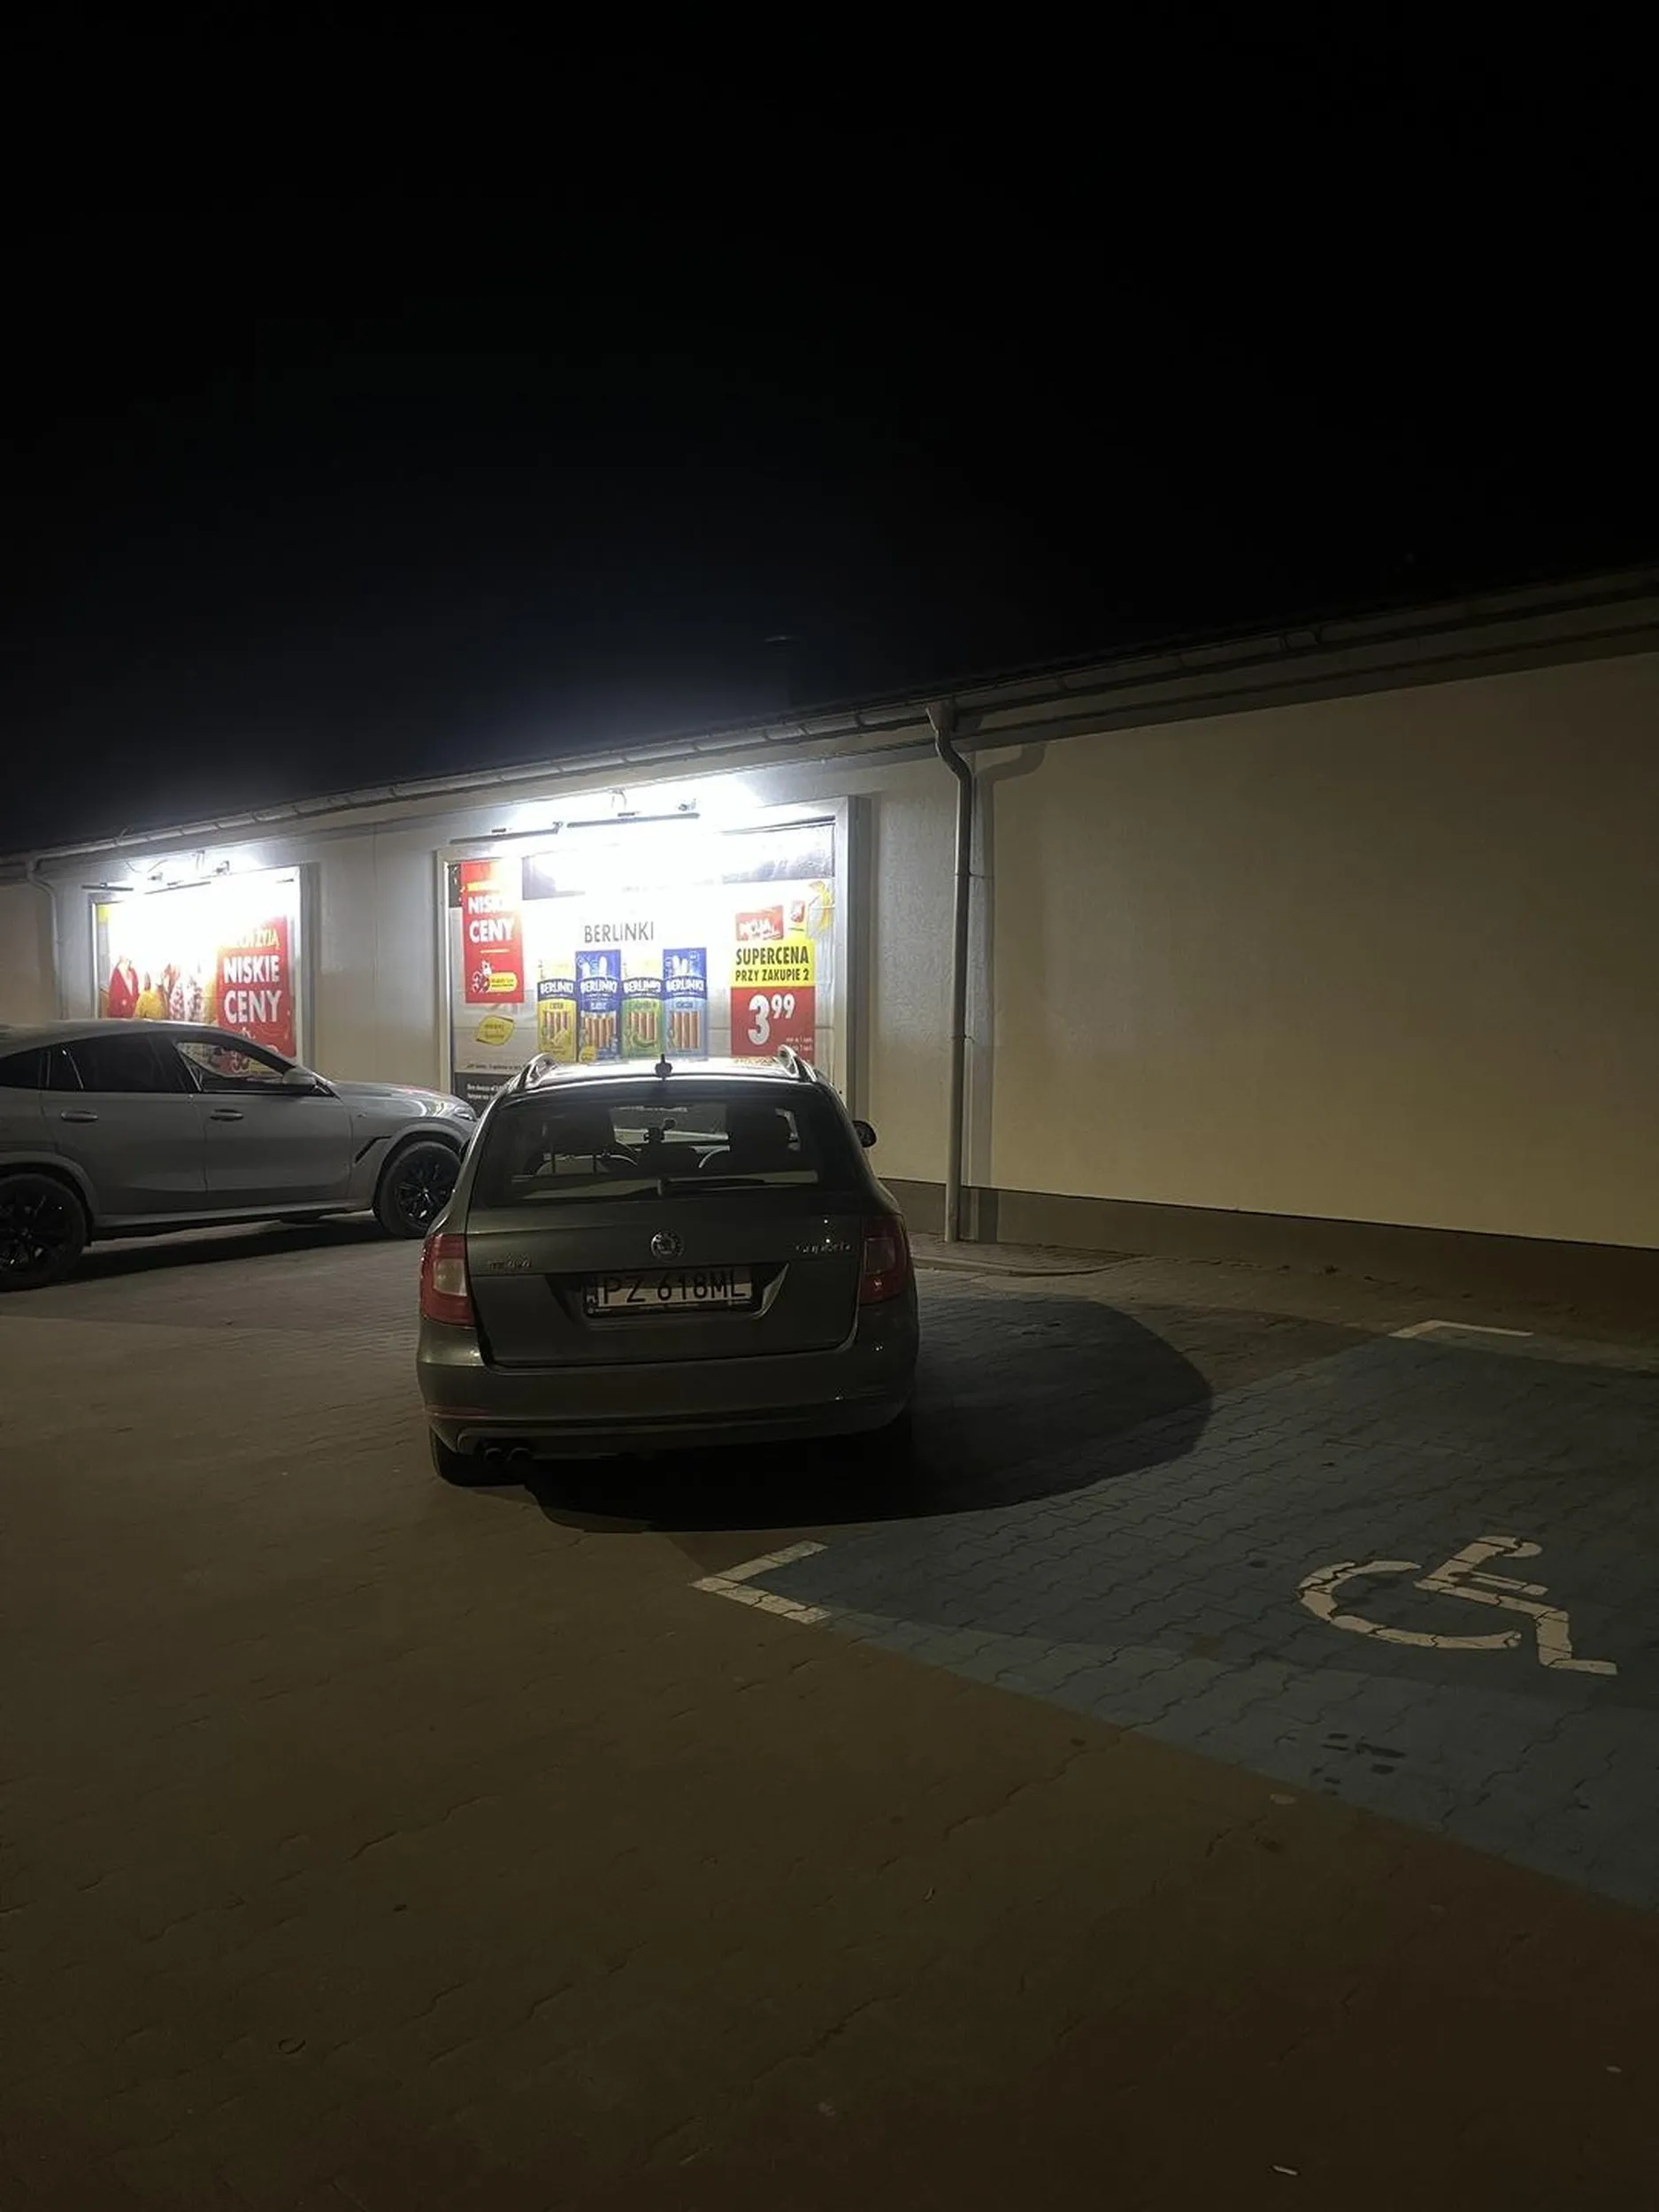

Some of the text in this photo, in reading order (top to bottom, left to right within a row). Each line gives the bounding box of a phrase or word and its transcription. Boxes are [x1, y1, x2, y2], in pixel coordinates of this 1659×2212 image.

[469, 919, 515, 943] CENY
[583, 921, 655, 943] BERLINKI
[735, 946, 810, 966] SUPERCENA
[224, 956, 280, 984] NISKIE
[735, 968, 810, 981] PRZY ZAKUPIE 2
[224, 990, 281, 1024] CENY
[602, 1268, 746, 1304] PZ 618ML
